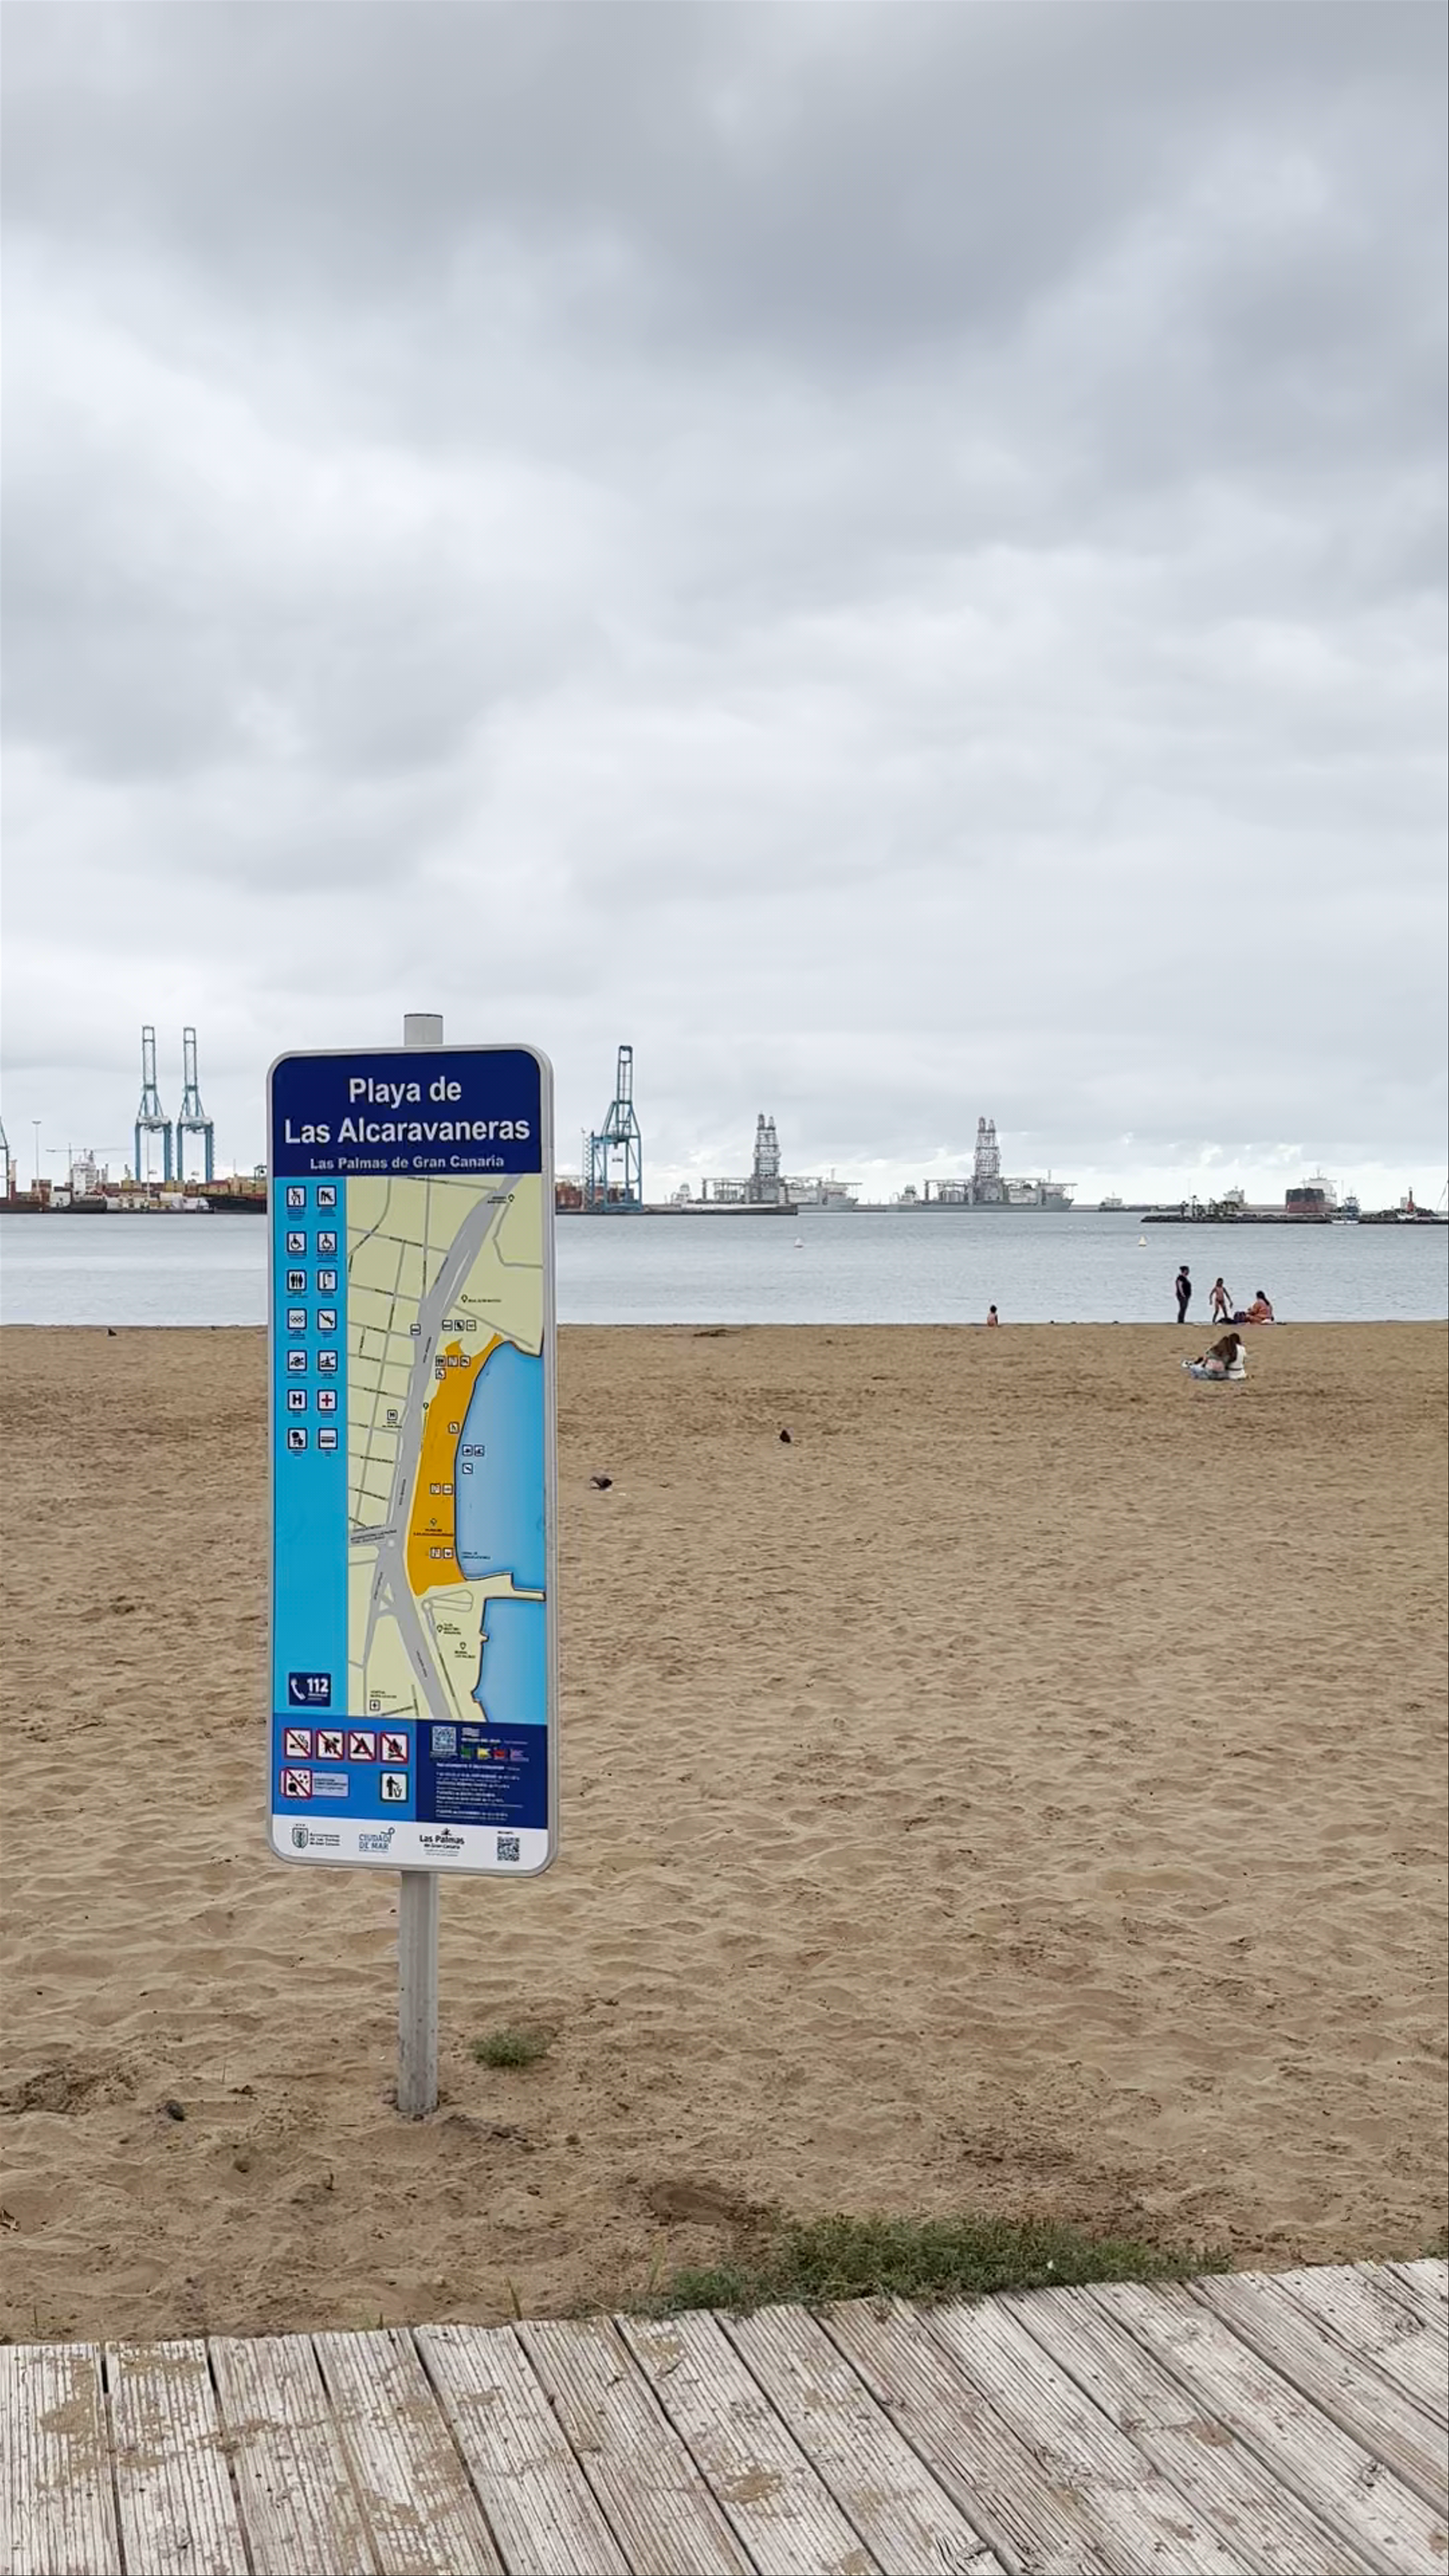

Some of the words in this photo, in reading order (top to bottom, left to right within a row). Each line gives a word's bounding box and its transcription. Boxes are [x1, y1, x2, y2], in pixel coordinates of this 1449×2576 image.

[349, 1077, 421, 1109] Playa
[429, 1076, 462, 1102] de
[285, 1119, 331, 1144] Las
[337, 1117, 530, 1143] Alcaravaneras
[310, 1158, 334, 1169] Las
[338, 1157, 388, 1169] Palmas
[391, 1156, 409, 1169] de
[412, 1155, 446, 1168] Gran
[450, 1155, 505, 1167] Canaria
[292, 1394, 302, 1405] H
[307, 1678, 329, 1693] 112
[359, 1833, 390, 1842] CIUDAD
[435, 1835, 465, 1845] Palmas
